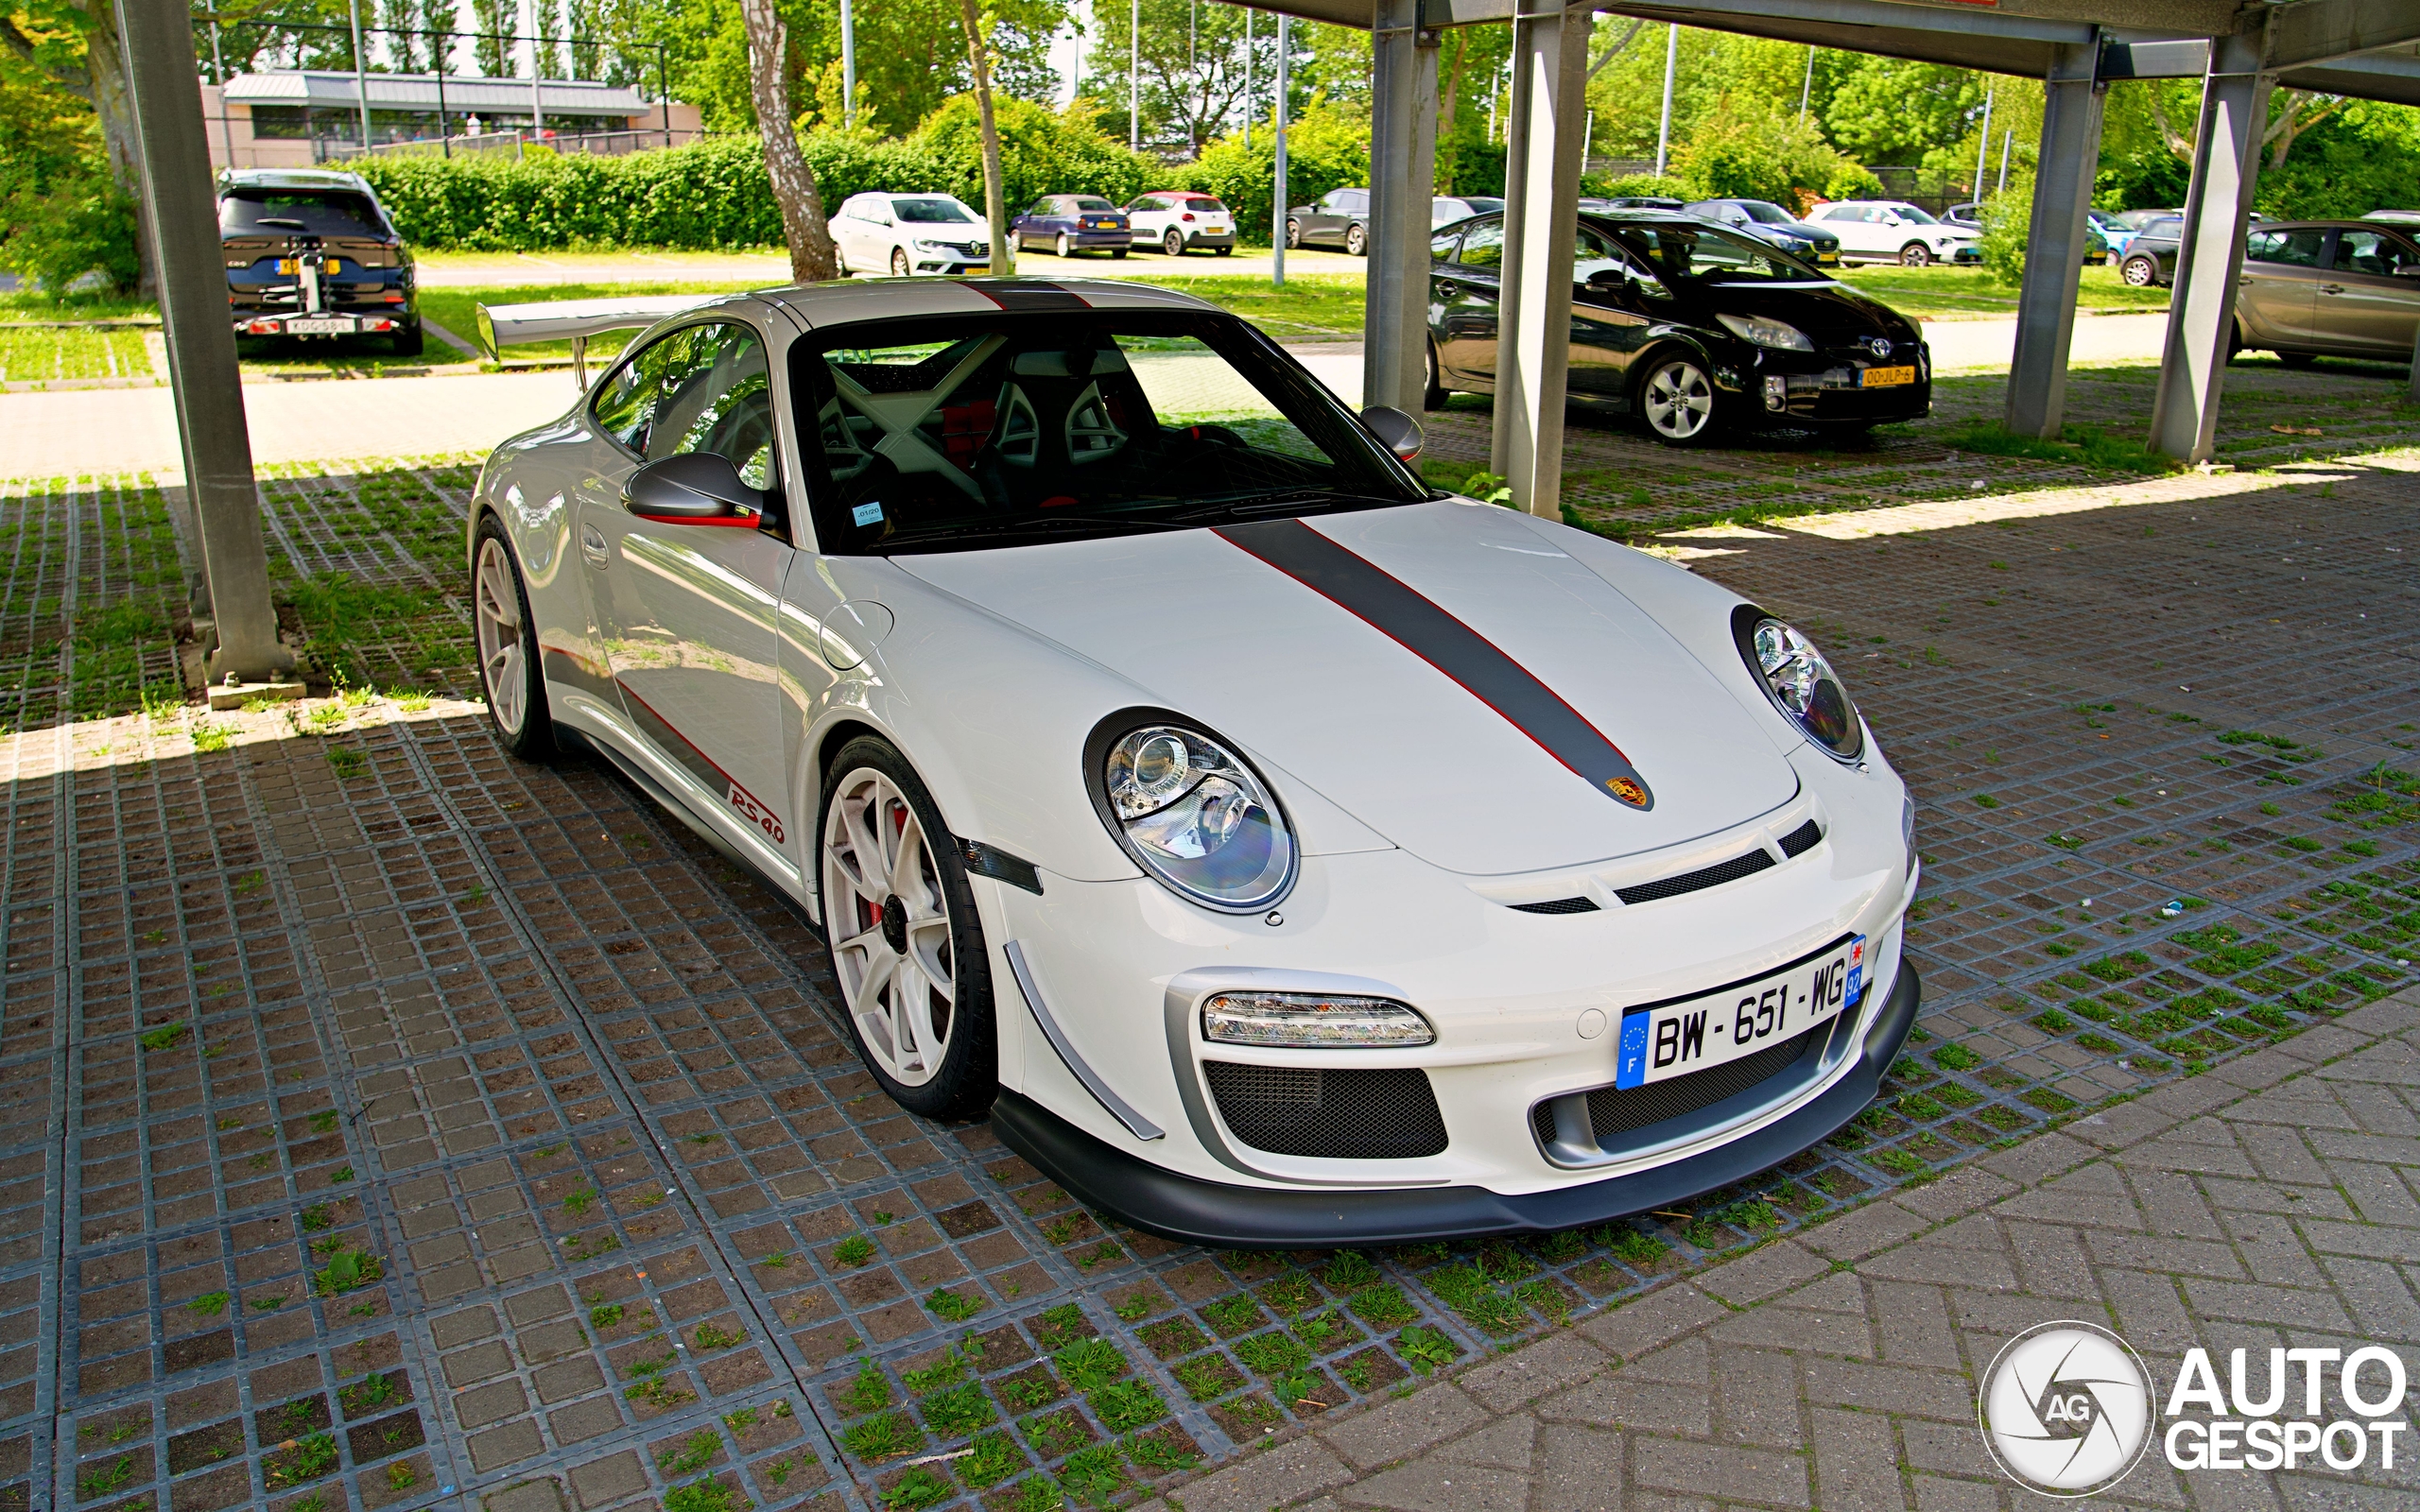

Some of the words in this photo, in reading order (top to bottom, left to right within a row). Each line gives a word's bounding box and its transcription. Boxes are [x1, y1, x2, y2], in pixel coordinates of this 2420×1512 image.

[731, 789, 758, 823] RS
[1846, 972, 1860, 997] 92
[1627, 1057, 1637, 1074] F
